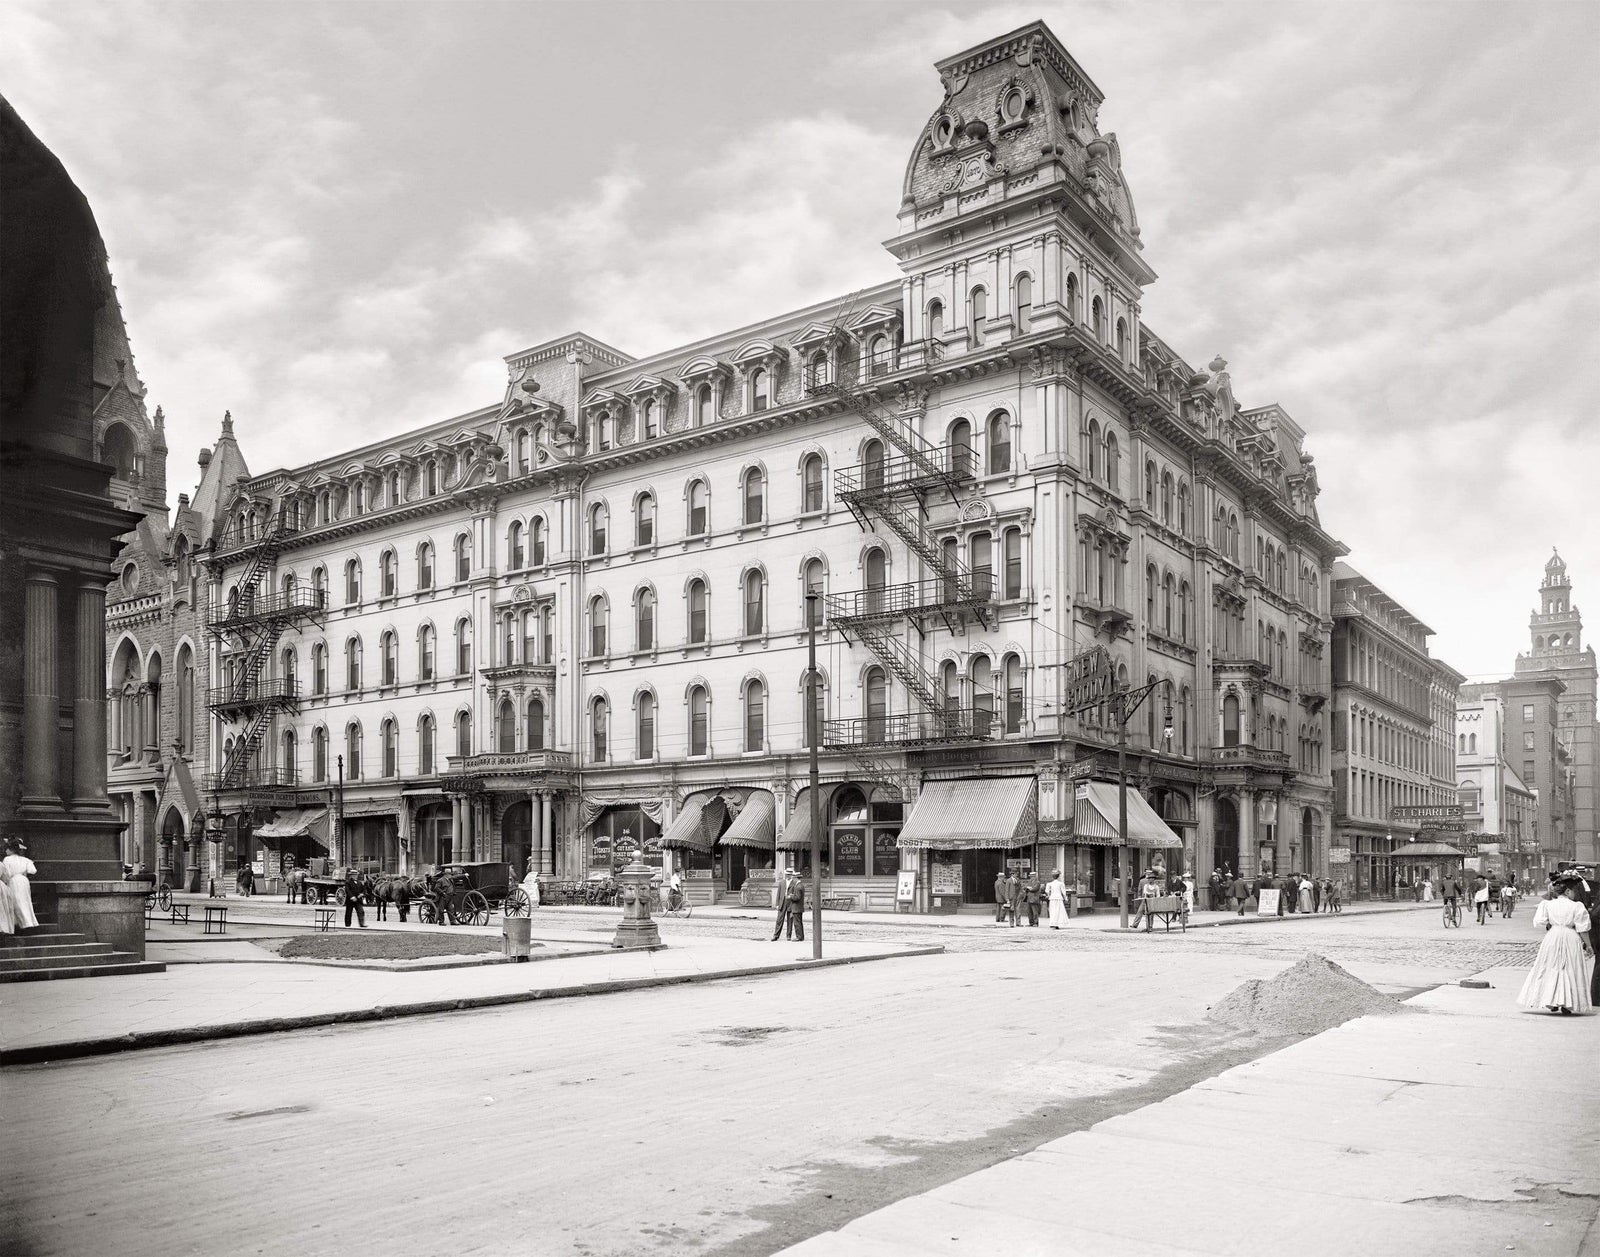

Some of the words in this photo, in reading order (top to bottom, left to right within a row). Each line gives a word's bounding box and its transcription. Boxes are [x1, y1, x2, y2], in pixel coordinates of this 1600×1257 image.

[1072, 652, 1100, 681] NEW
[1067, 674, 1108, 710] BOODY
[1393, 807, 1406, 817] ST
[1410, 807, 1461, 817] CHARLES
[898, 839, 923, 847] BOODY
[985, 839, 1012, 847] STORE
[841, 846, 859, 855] CLUB
